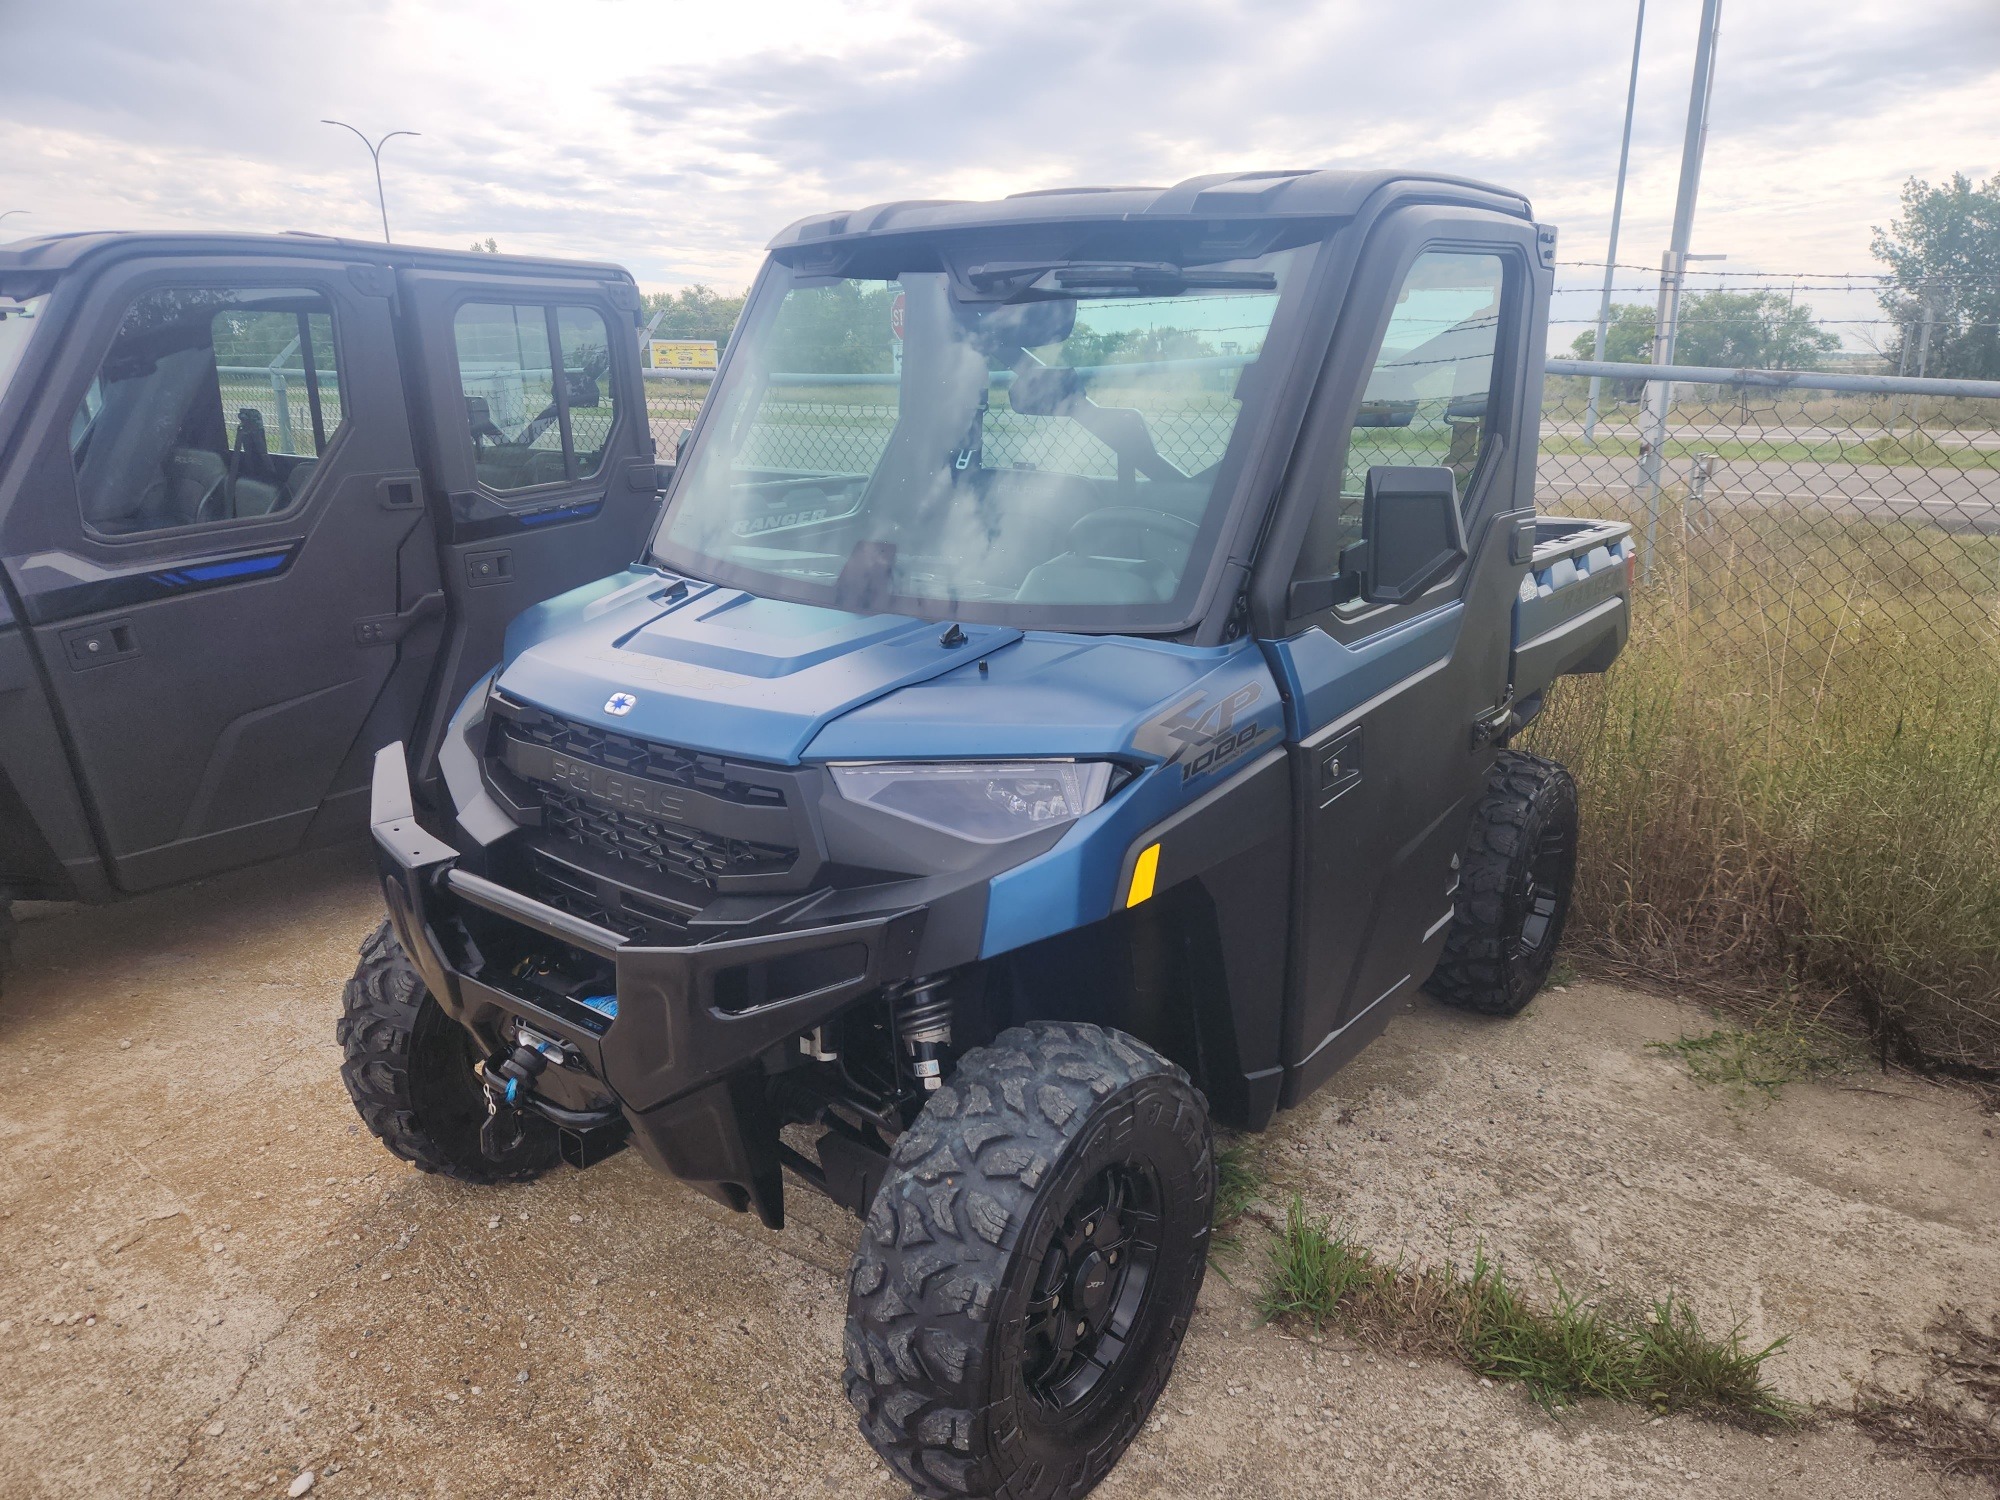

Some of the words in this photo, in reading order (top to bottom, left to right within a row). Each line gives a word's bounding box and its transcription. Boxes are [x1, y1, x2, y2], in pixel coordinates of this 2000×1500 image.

[893, 308, 904, 327] ST
[732, 509, 827, 534] RANGER
[1153, 681, 1264, 776] XP
[1182, 722, 1259, 783] 1000
[552, 759, 685, 820] POLARIS
[1086, 1281, 1105, 1289] XP
